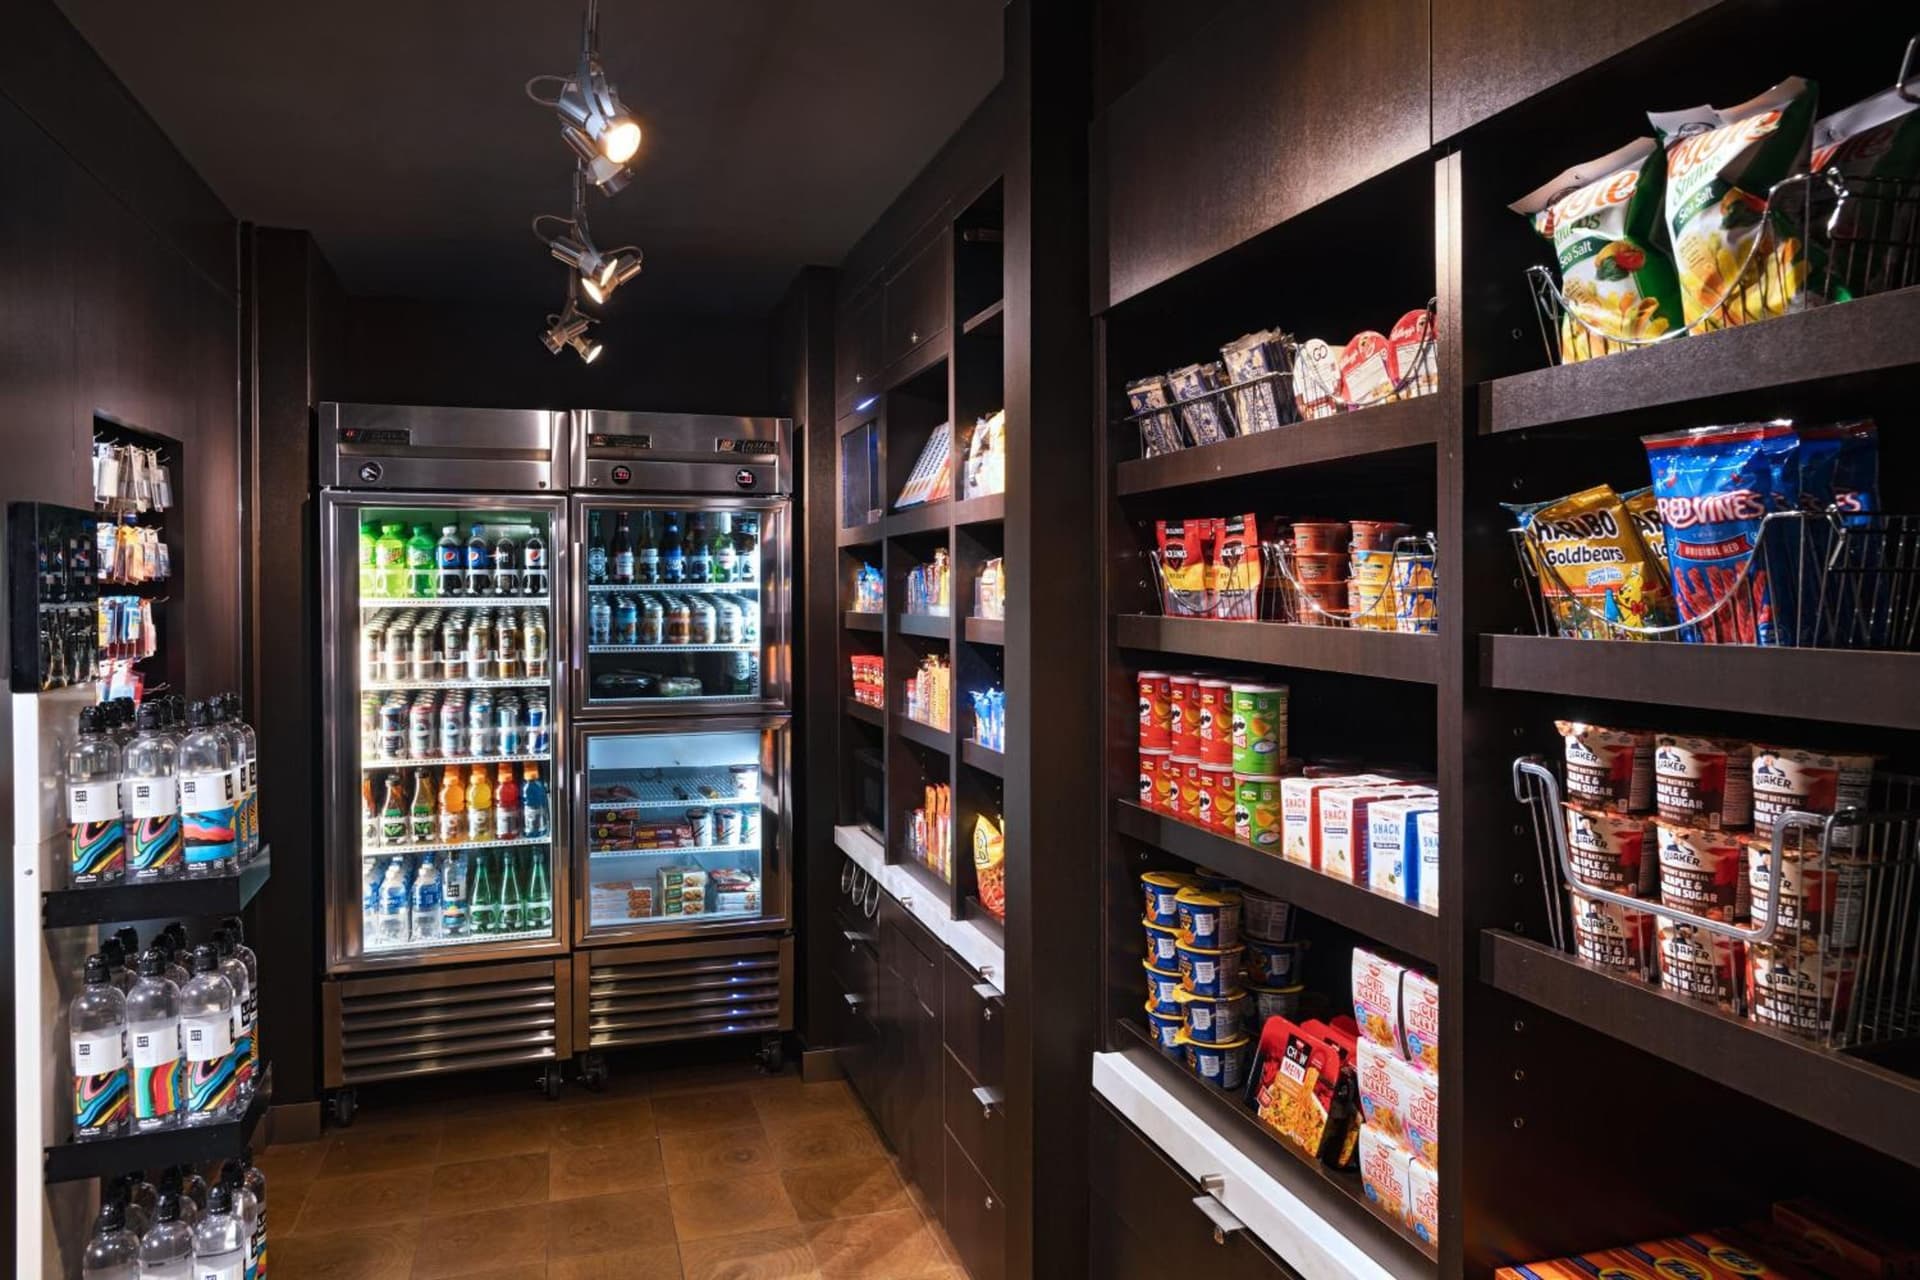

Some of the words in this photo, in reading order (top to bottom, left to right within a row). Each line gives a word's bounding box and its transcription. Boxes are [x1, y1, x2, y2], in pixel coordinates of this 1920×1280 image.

[1679, 203, 1694, 224] Sea
[1695, 186, 1714, 210] Salt
[1559, 252, 1573, 266] Sea
[1573, 241, 1592, 258] Salt
[1313, 344, 1328, 361] GO
[1658, 497, 1698, 529] RED
[1693, 489, 1765, 523] VINES
[1533, 509, 1619, 541] HARIBO
[1545, 546, 1624, 566] Goldbears
[1685, 546, 1721, 557] ORIGINAL
[1722, 542, 1740, 554] RED
[1592, 776, 1599, 785] &
[1755, 775, 1793, 790] QUAKER
[1582, 784, 1613, 797] SUGAR
[1680, 787, 1688, 797] &
[1285, 798, 1306, 809] SNACK
[1671, 795, 1704, 809] SUGAR
[1324, 810, 1347, 821] SNACK
[1373, 822, 1400, 834] SNACK
[1575, 835, 1608, 849] QUAKER
[1664, 851, 1700, 867] QUAKER
[1592, 868, 1624, 881] SUGAR
[1602, 862, 1610, 872] &
[1694, 881, 1703, 891] &
[1754, 872, 1792, 889] QUAR
[1682, 887, 1718, 903] SUGAR
[1777, 915, 1811, 930] UGAR
[1365, 974, 1384, 993] CUP
[1703, 973, 1711, 984] &
[1765, 974, 1816, 992] QUAKER
[1283, 1060, 1303, 1081] MEIN
[1370, 1065, 1391, 1085] CUP
